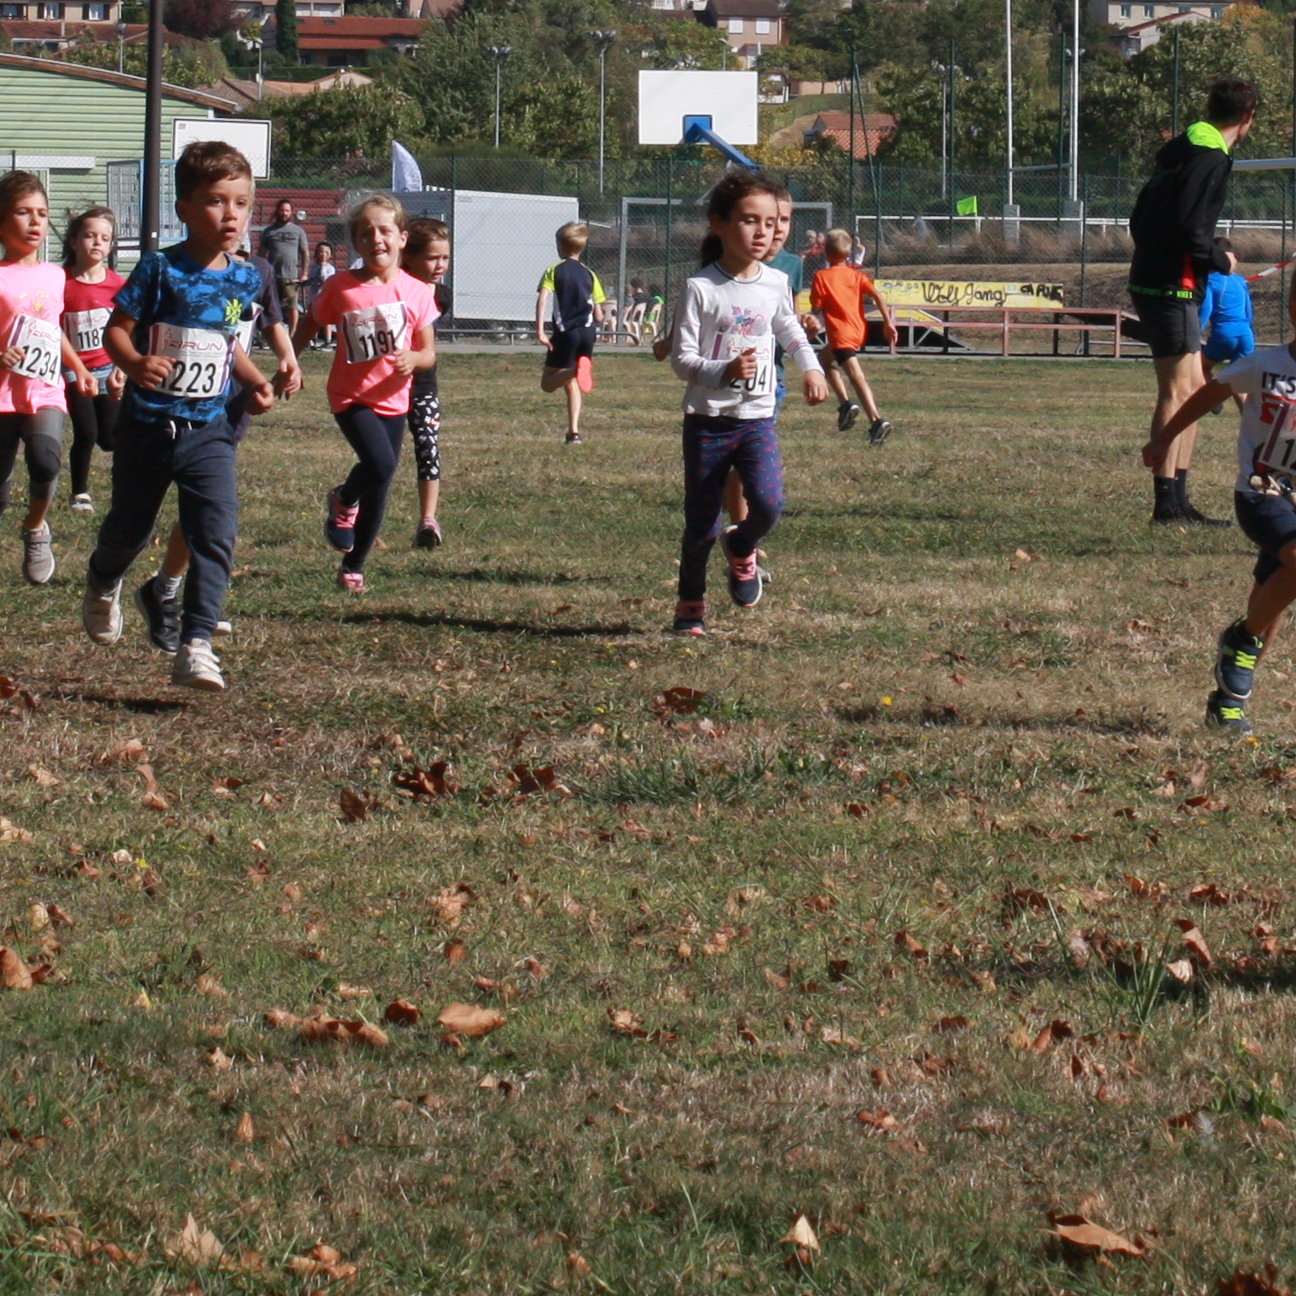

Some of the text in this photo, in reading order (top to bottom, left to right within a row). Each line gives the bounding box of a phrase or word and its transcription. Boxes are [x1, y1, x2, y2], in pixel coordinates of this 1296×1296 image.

[359, 329, 396, 359] 1191
[18, 345, 59, 381] 1234
[161, 360, 216, 393] 223
